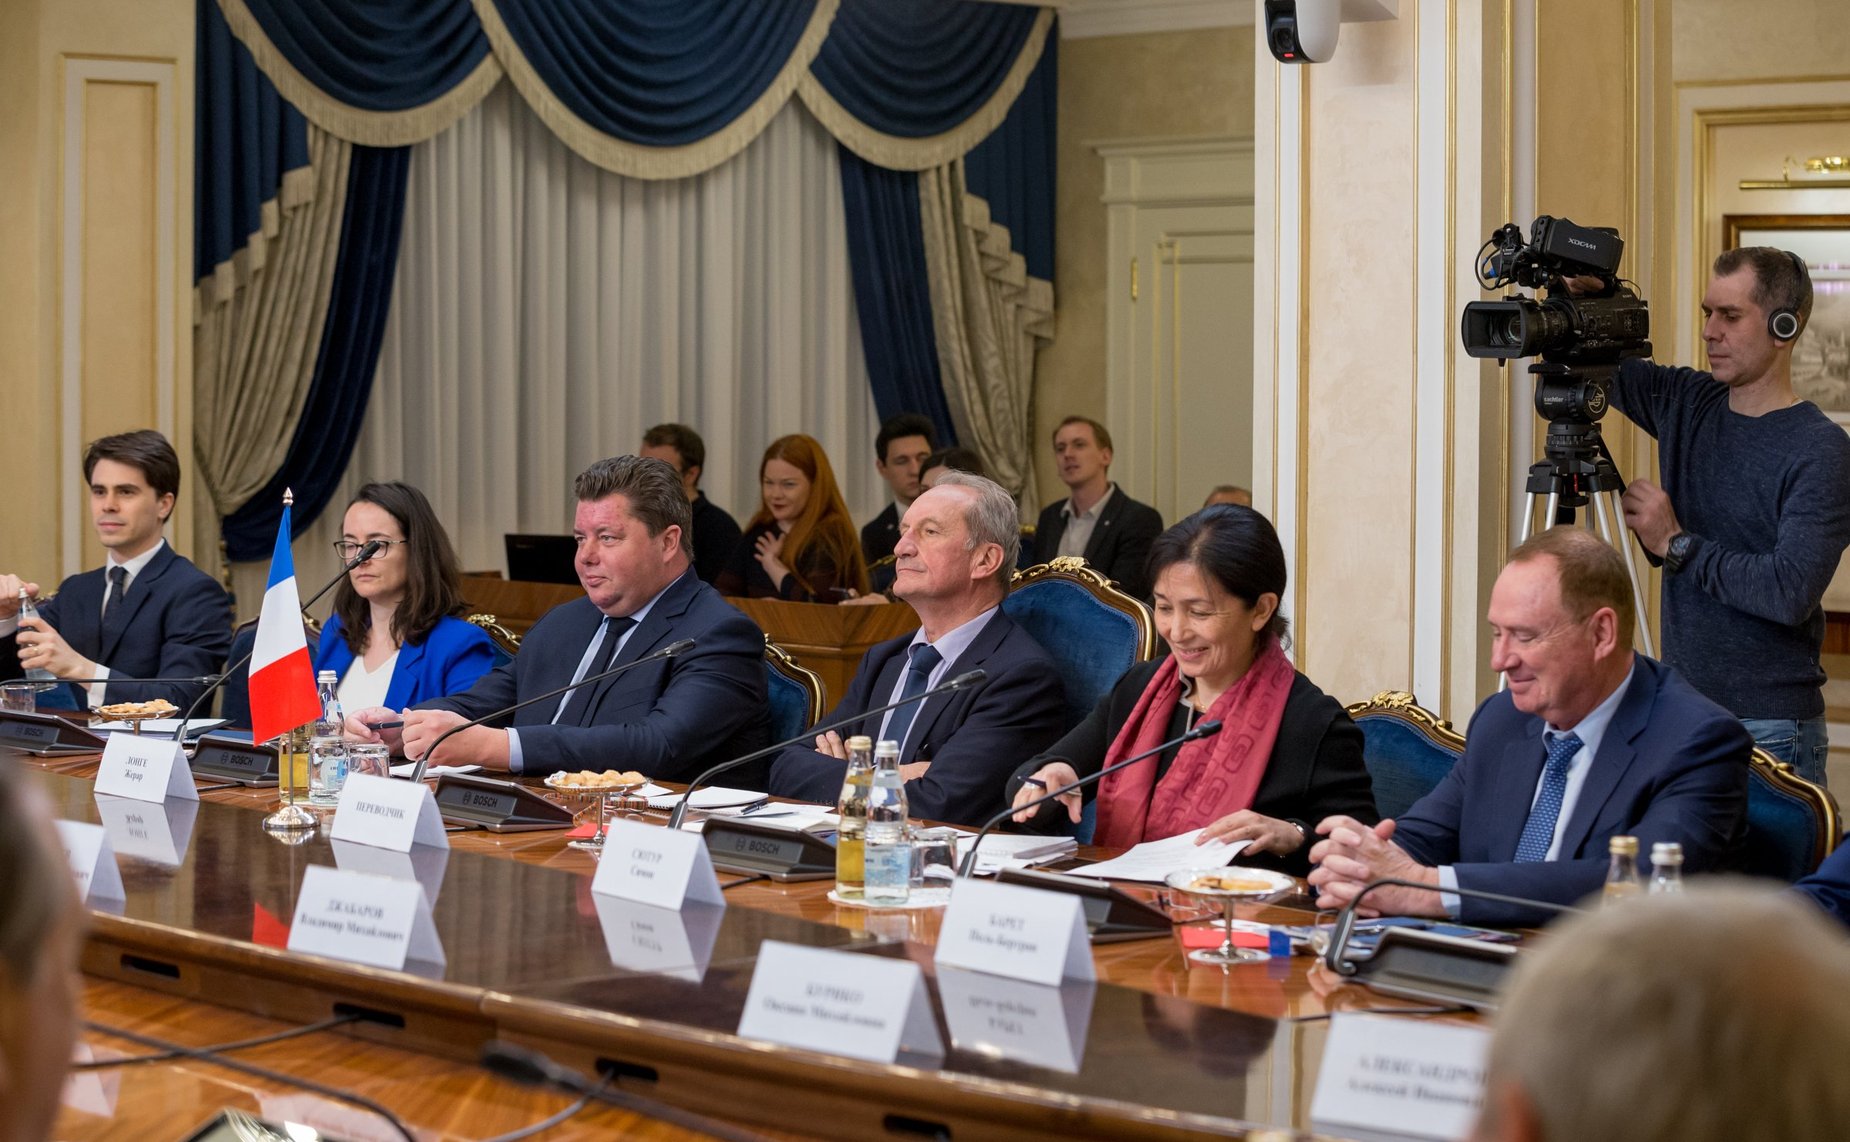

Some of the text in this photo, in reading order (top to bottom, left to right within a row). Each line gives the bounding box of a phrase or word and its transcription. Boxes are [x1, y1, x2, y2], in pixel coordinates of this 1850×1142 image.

[24, 727, 44, 737] BOSCH
[125, 755, 149, 767] ЛОНГЕ
[230, 754, 254, 766] BOSCH
[473, 795, 498, 808] BOSCH
[355, 801, 406, 819] ПЕРЕВОДЧИК
[749, 840, 780, 855] BOSCH
[325, 899, 384, 919] ДЖАБАРОВ
[300, 912, 405, 941] Владимир Михайлович
